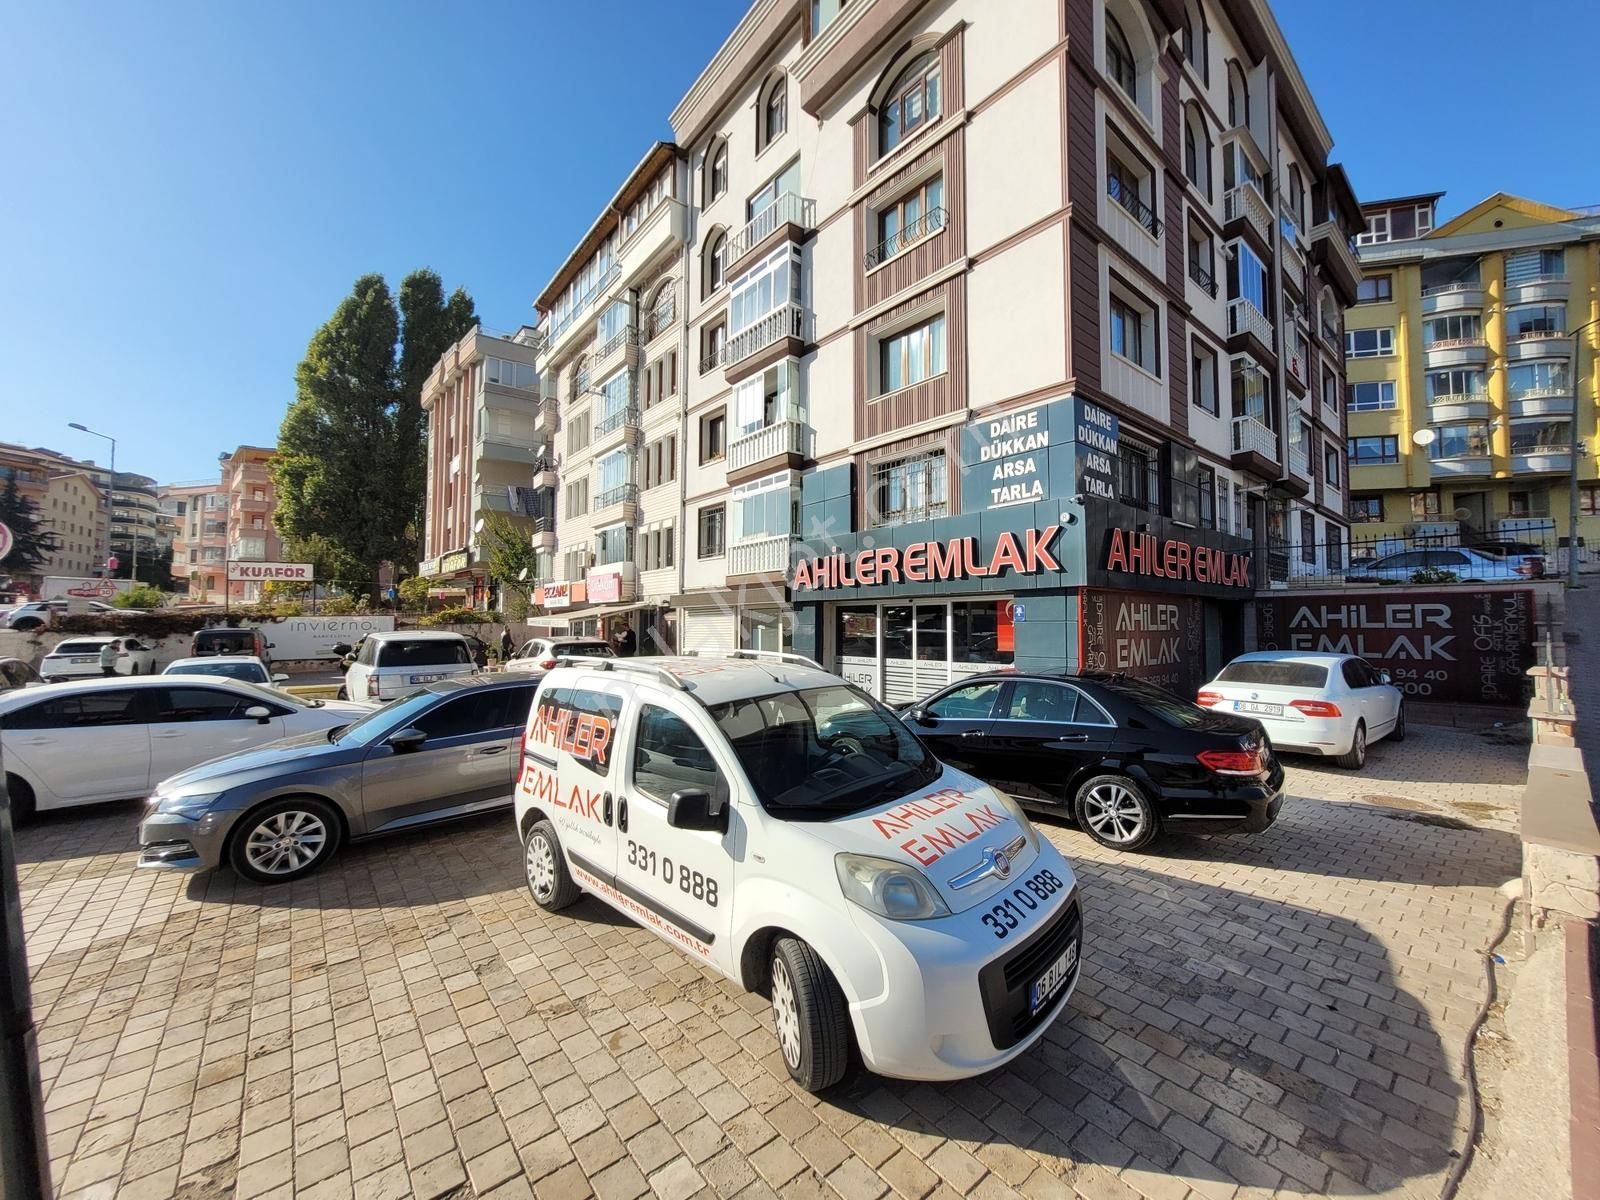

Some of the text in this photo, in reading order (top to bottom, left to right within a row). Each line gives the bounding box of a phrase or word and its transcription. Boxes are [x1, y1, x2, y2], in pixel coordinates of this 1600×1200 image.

[990, 411, 1038, 438] DAİRE
[1084, 405, 1112, 431] DAİRE
[981, 430, 1049, 461] DÜKKAN
[1078, 425, 1117, 455] DÜKKAN
[993, 458, 1036, 480] ARSA
[1086, 453, 1112, 476] ARSA
[991, 480, 1043, 504] TARLA
[1084, 475, 1114, 499] TARLA
[240, 565, 305, 578] KUAFÖR
[1195, 546, 1250, 588] EMLAK
[1116, 637, 1181, 668] EMLAK
[1291, 634, 1458, 660] EMLAK
[1395, 668, 1418, 679] 94
[1424, 670, 1448, 681] 40
[523, 766, 602, 823] EMLAK
[900, 804, 1010, 867] EMLAK
[627, 840, 656, 876] 331
[679, 865, 718, 907] 888
[981, 898, 1027, 939] 331
[1024, 869, 1063, 901] 888
